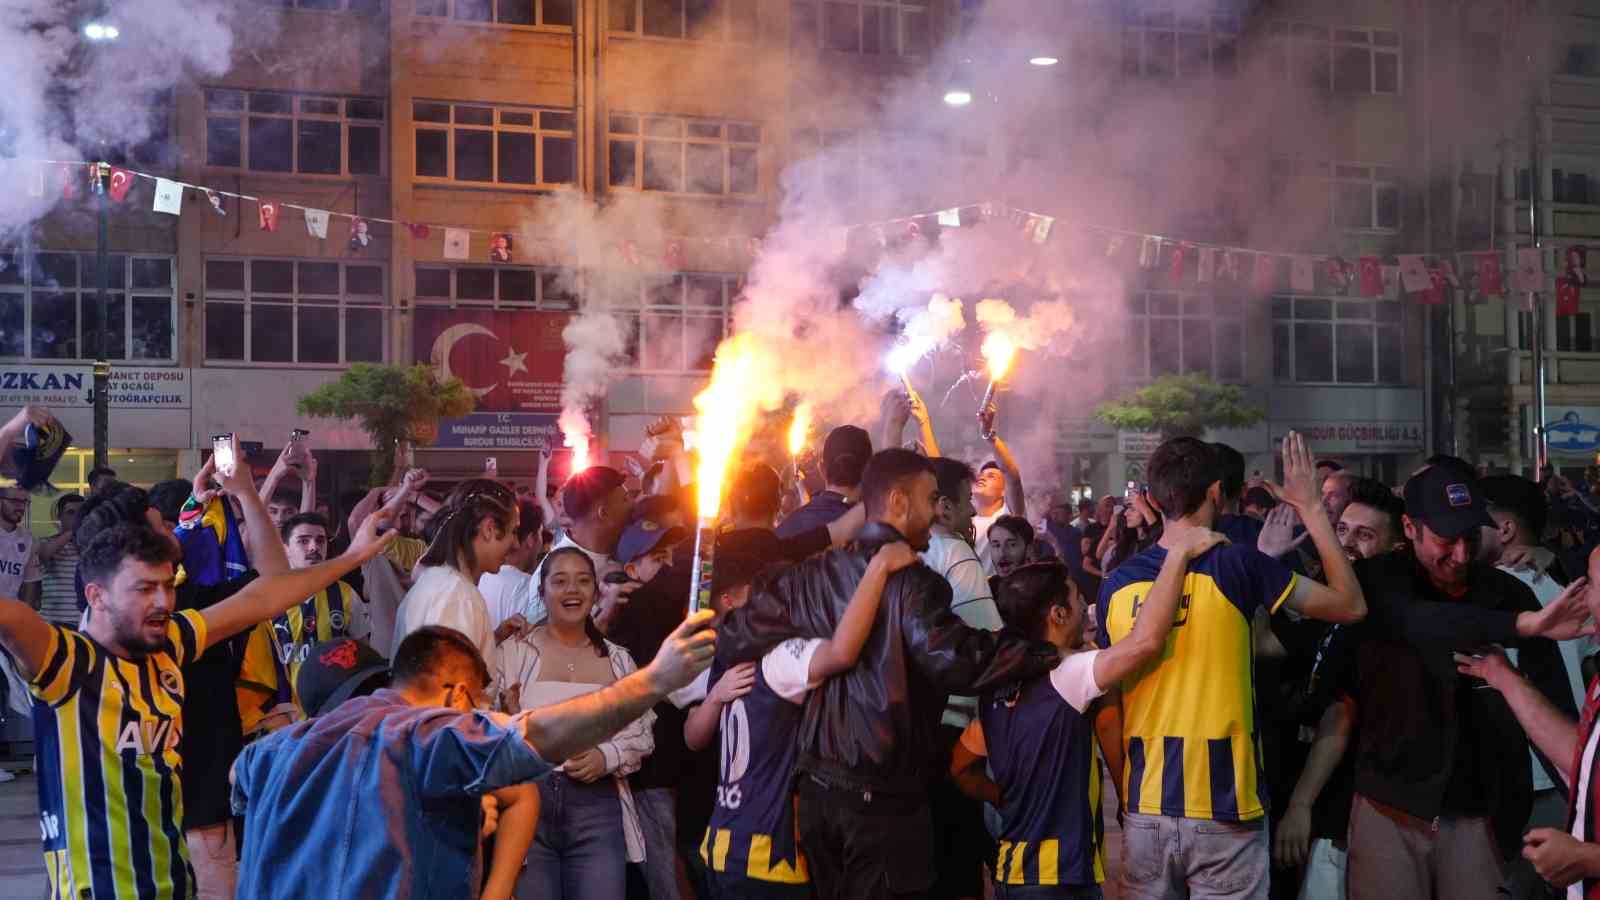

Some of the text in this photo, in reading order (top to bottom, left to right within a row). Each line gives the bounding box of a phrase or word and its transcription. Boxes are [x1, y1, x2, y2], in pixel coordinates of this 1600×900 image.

[0, 372, 83, 390] ZKAN
[108, 371, 184, 381] ANET DEPOSU
[106, 392, 182, 405] OTOĞRAFÇILIK
[0, 559, 22, 576] VIS
